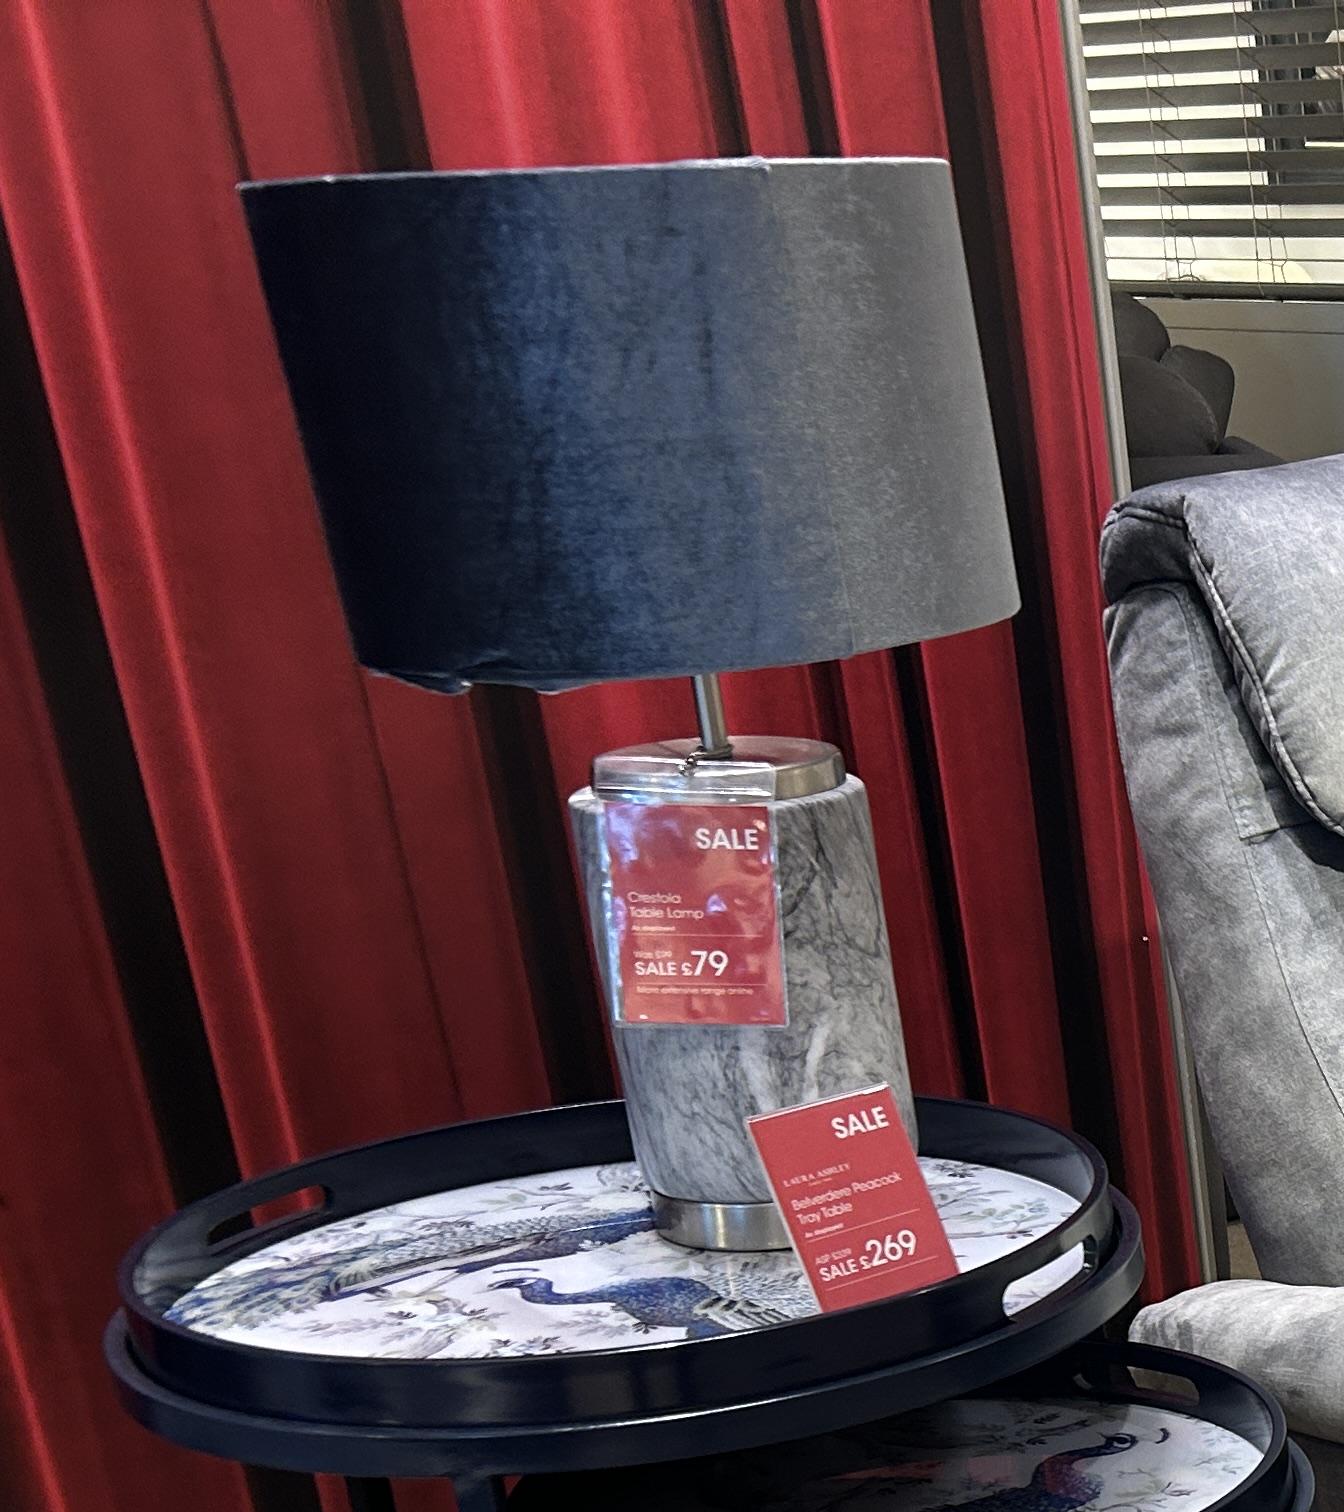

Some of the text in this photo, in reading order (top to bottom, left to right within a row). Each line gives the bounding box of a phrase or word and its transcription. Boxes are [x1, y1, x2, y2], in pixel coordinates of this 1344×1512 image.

[694, 827, 760, 851] SALE
[629, 906, 705, 921] Table Lamp
[633, 950, 730, 978] SALE £79
[830, 1105, 891, 1139] SALE
[783, 1173, 817, 1188] LAURA
[816, 1162, 851, 1179] ASHLEY
[851, 1171, 904, 1194] Peacock
[796, 1202, 854, 1226] Tray Table
[819, 1228, 918, 1282] SALE £269
